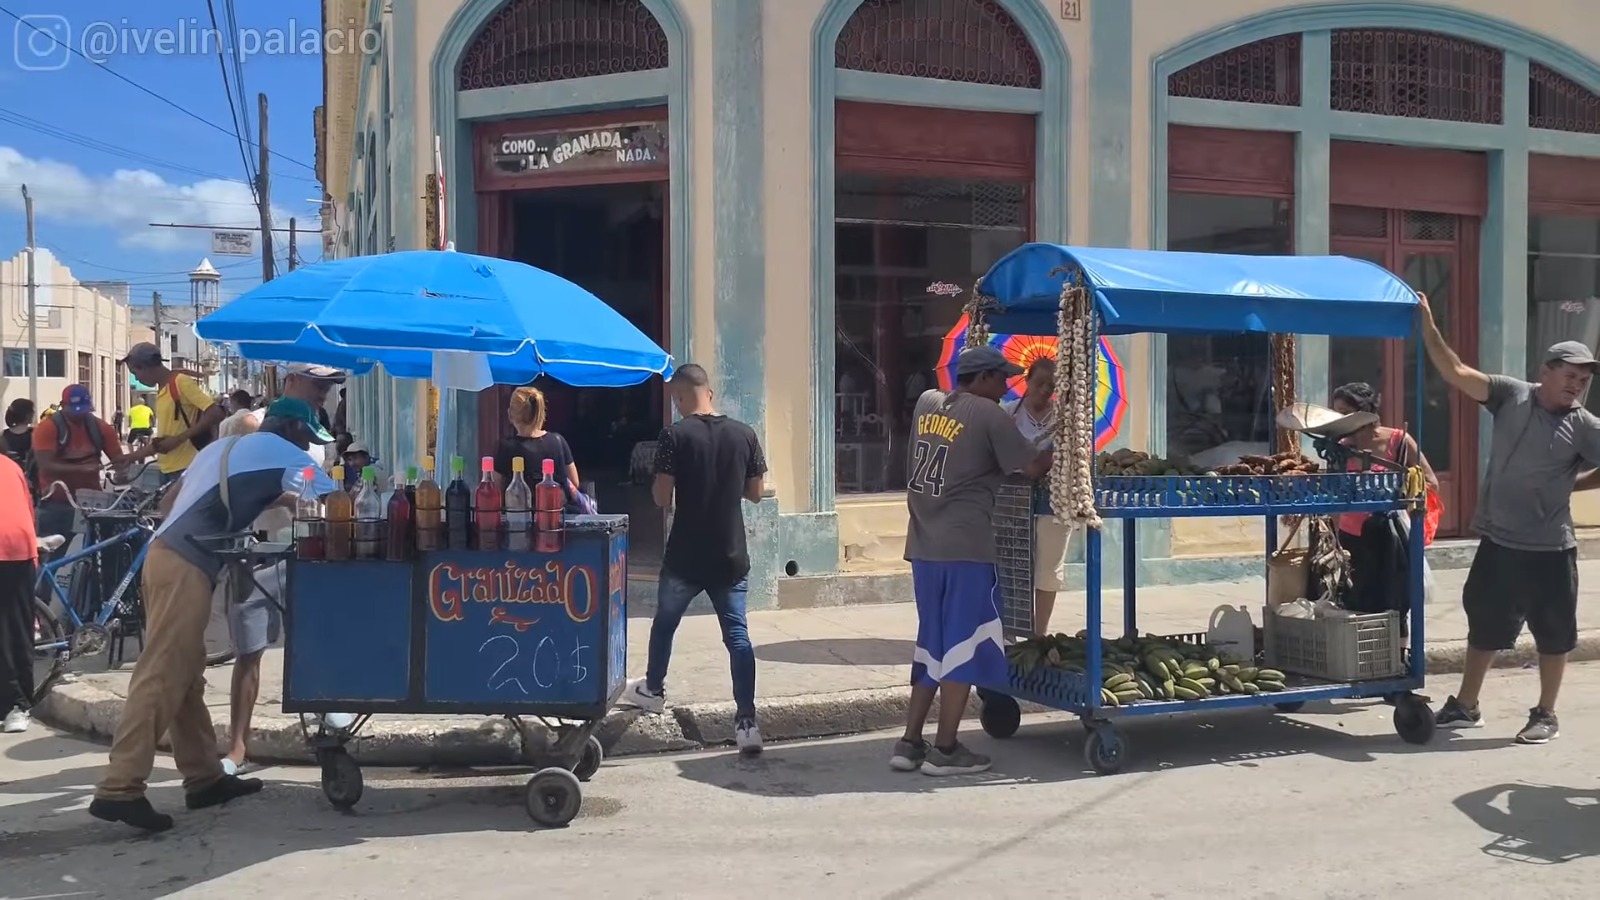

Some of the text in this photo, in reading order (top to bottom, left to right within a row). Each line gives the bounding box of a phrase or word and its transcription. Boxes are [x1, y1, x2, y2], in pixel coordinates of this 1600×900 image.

[1064, 1, 1077, 17] 21
[502, 139, 549, 154] COMO...
[528, 154, 550, 170] LA
[616, 148, 657, 163] NADA.
[918, 413, 964, 442] GEORGE
[907, 440, 949, 498] 24
